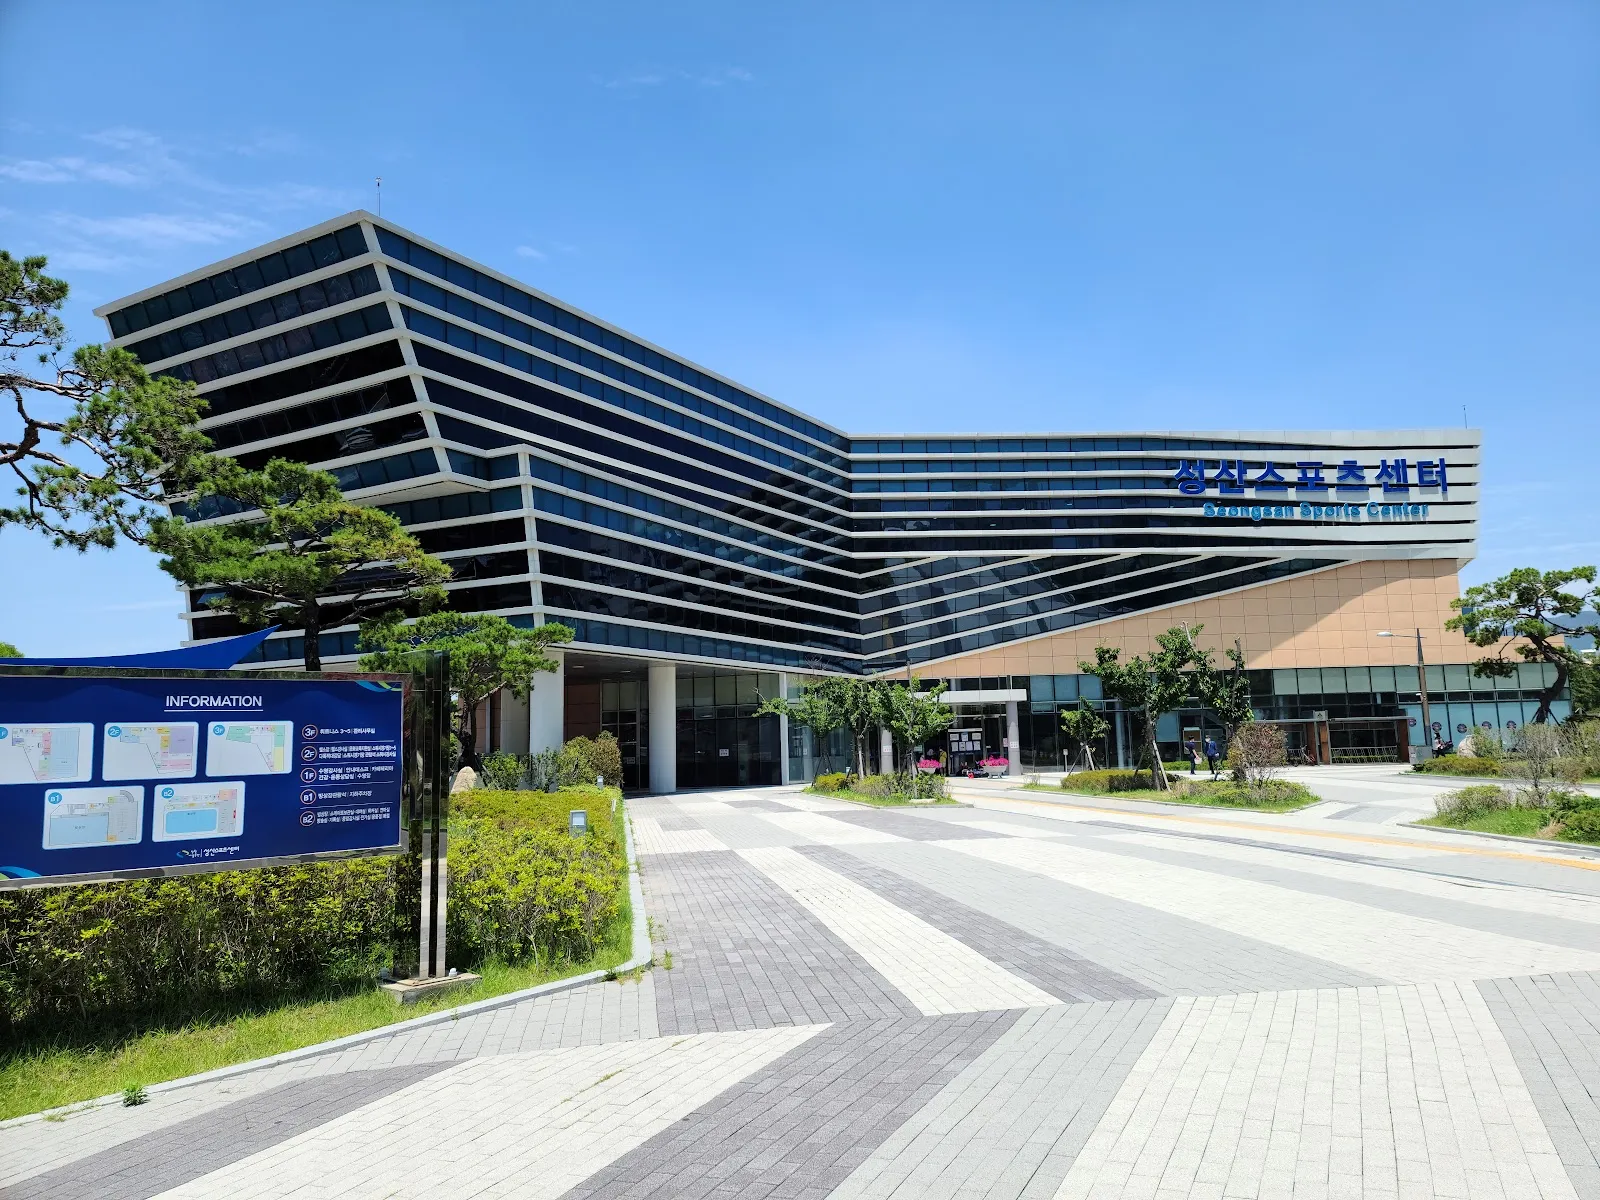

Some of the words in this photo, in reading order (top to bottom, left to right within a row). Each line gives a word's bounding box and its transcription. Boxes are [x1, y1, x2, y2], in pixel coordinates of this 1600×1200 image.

[1174, 457, 1447, 494] 성산스포츠센터
[1203, 502, 1294, 521] Seongsan
[1300, 501, 1361, 519] Sports
[1367, 501, 1429, 517] Center
[165, 695, 262, 707] INFORMATION
[304, 728, 316, 736] 3F
[304, 750, 315, 758] 2F
[304, 772, 314, 780] 1F
[304, 793, 313, 801] B1
[302, 815, 313, 824] B2
